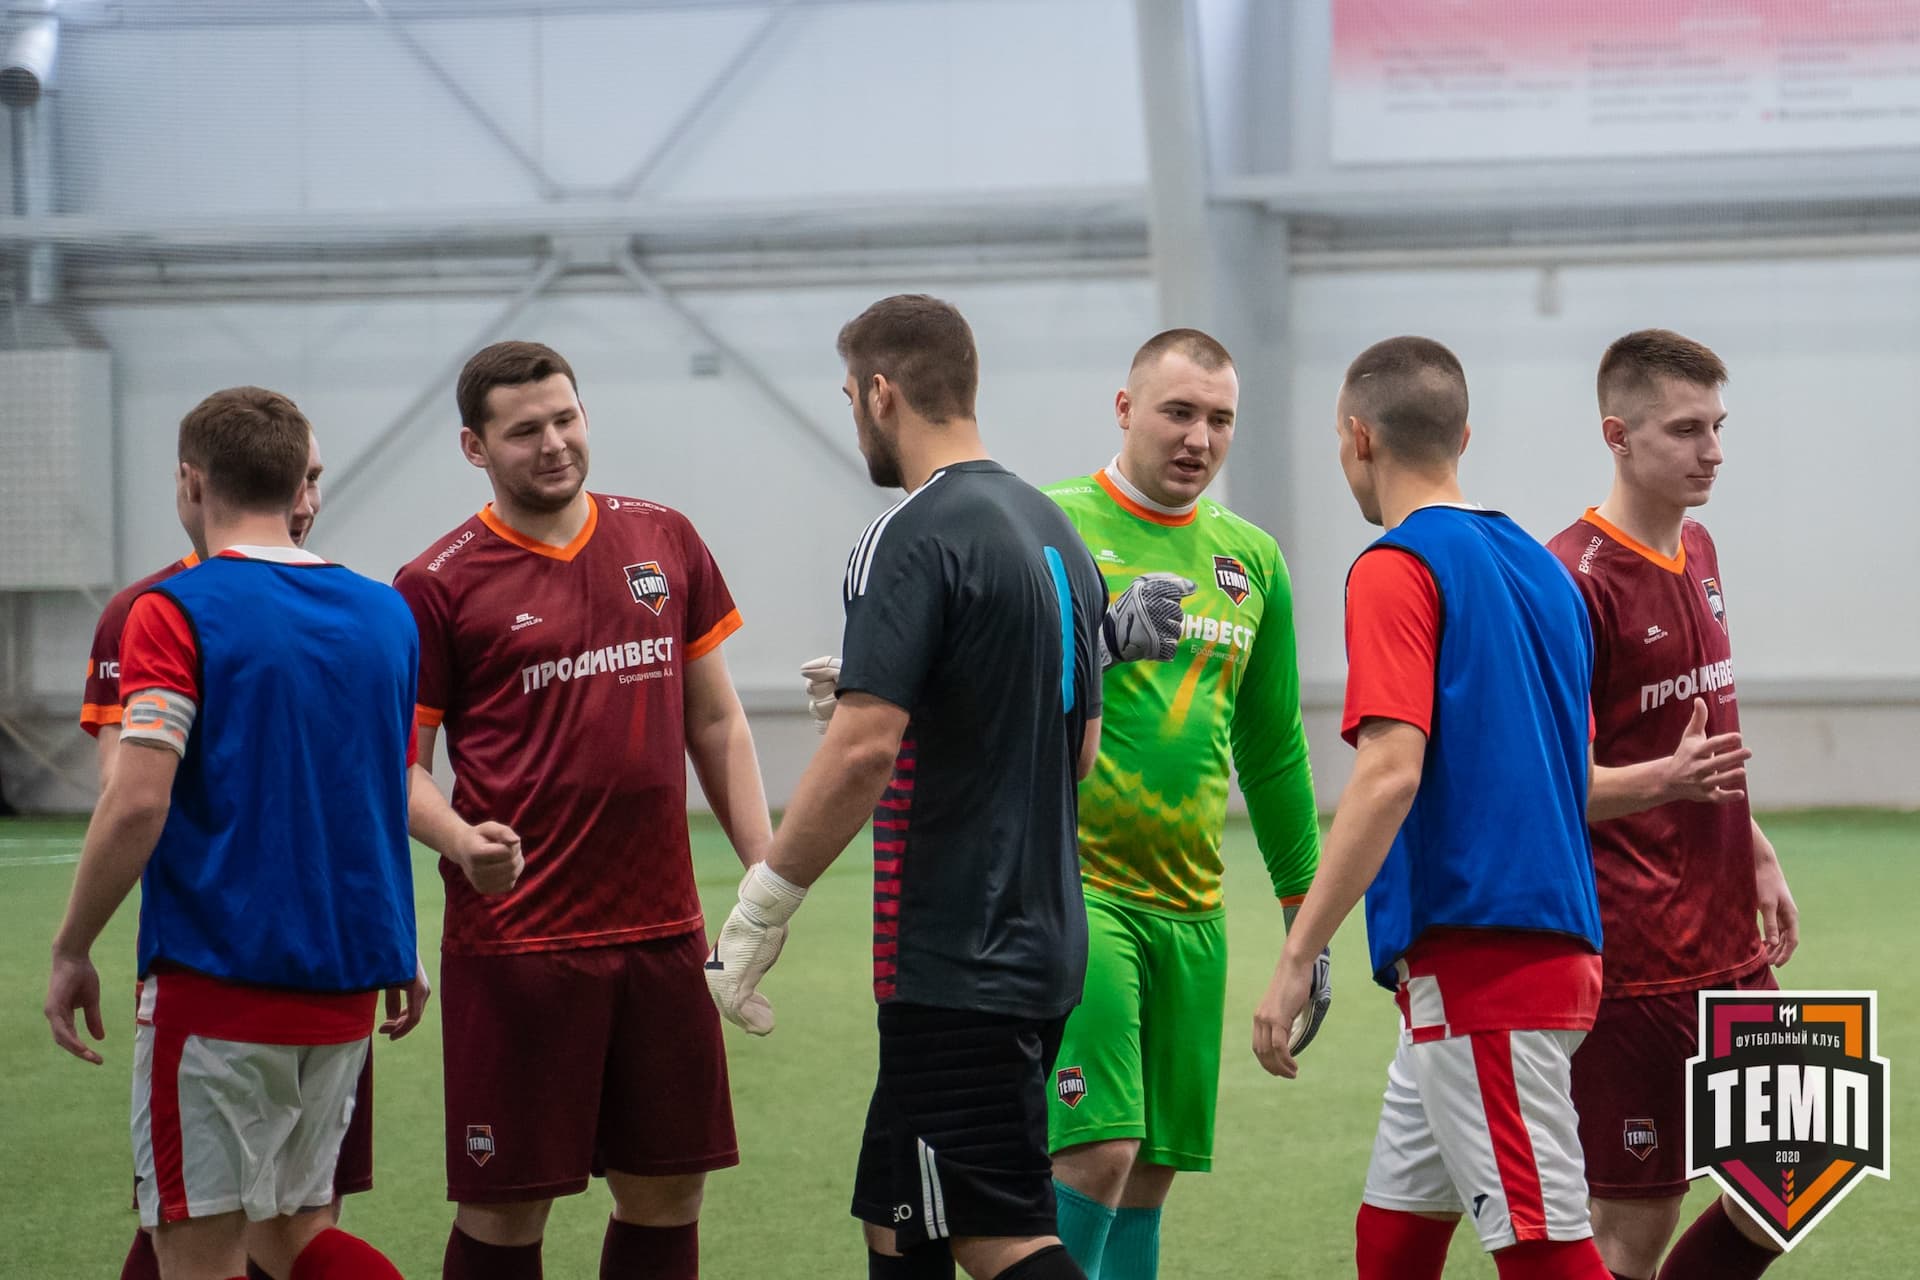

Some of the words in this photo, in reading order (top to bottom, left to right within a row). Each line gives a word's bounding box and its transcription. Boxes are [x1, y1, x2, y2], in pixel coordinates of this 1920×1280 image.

[632, 576, 666, 597] ТЕМП
[1217, 570, 1248, 592] ТЕМП
[521, 636, 673, 695] ПРОДИНВЕСТ
[1059, 1079, 1083, 1095] ТЕМП
[1627, 1131, 1654, 1146] ТЕМП
